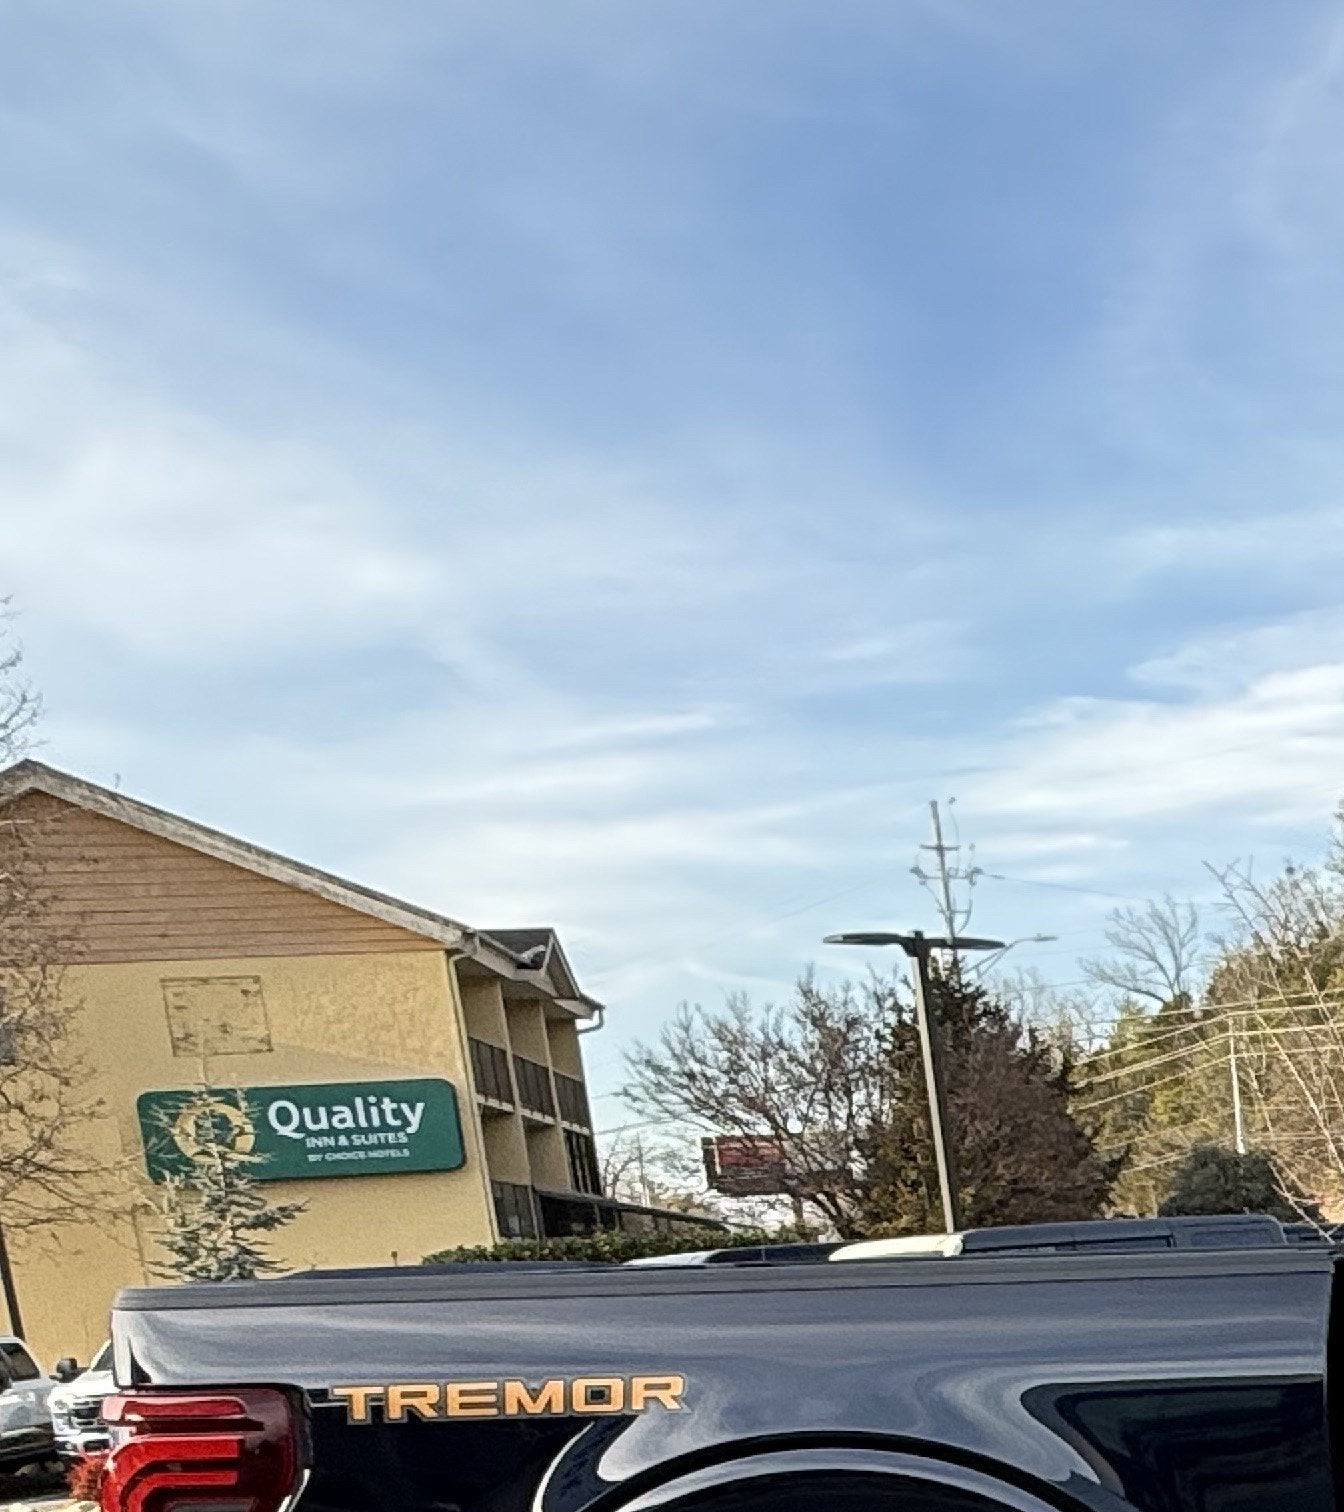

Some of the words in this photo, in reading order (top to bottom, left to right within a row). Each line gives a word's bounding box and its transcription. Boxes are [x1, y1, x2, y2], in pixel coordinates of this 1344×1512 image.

[267, 1094, 426, 1139] Quality
[304, 1136, 336, 1148] INN
[352, 1131, 409, 1146] SUITES
[331, 1374, 686, 1422] TREMOR
